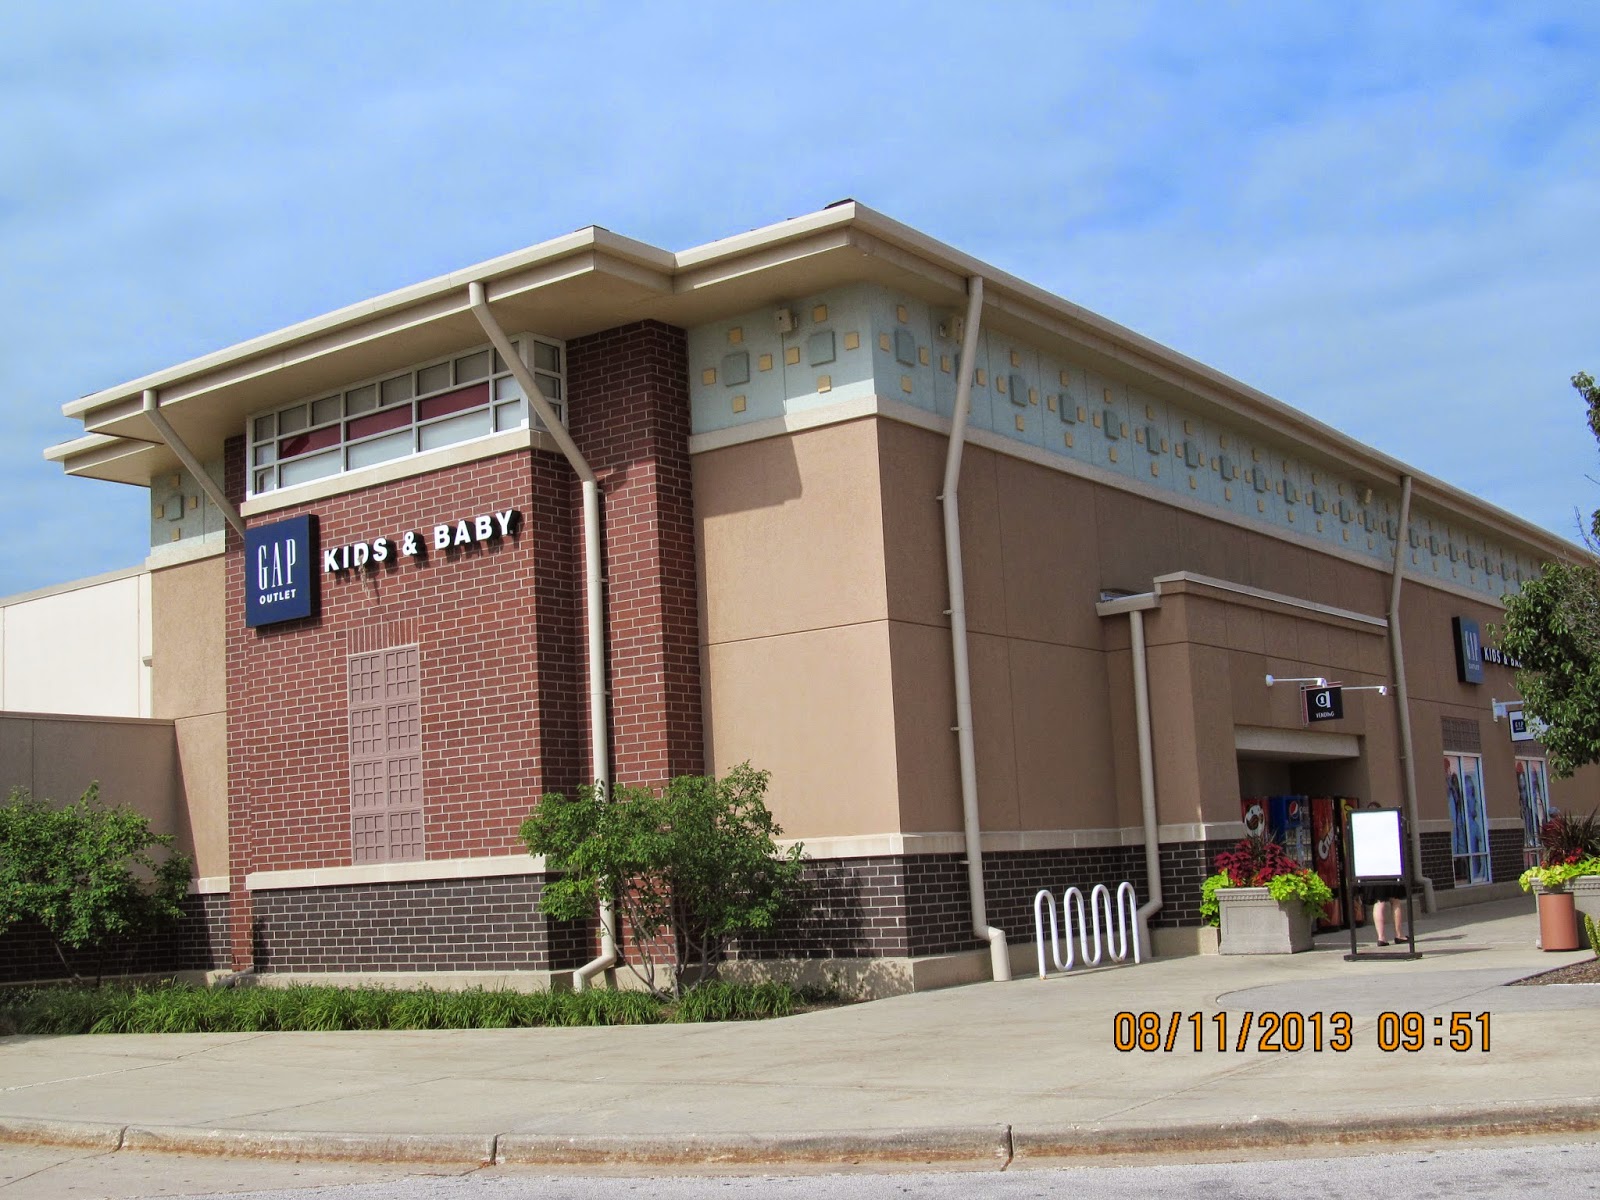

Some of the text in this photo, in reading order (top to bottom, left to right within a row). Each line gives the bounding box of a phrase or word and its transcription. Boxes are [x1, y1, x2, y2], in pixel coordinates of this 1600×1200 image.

[323, 509, 514, 573] KIDS & BABY
[257, 538, 297, 590] GAP
[259, 588, 297, 605] OUTLET
[1484, 646, 1501, 664] KIDS
[1315, 711, 1335, 719] VENDING
